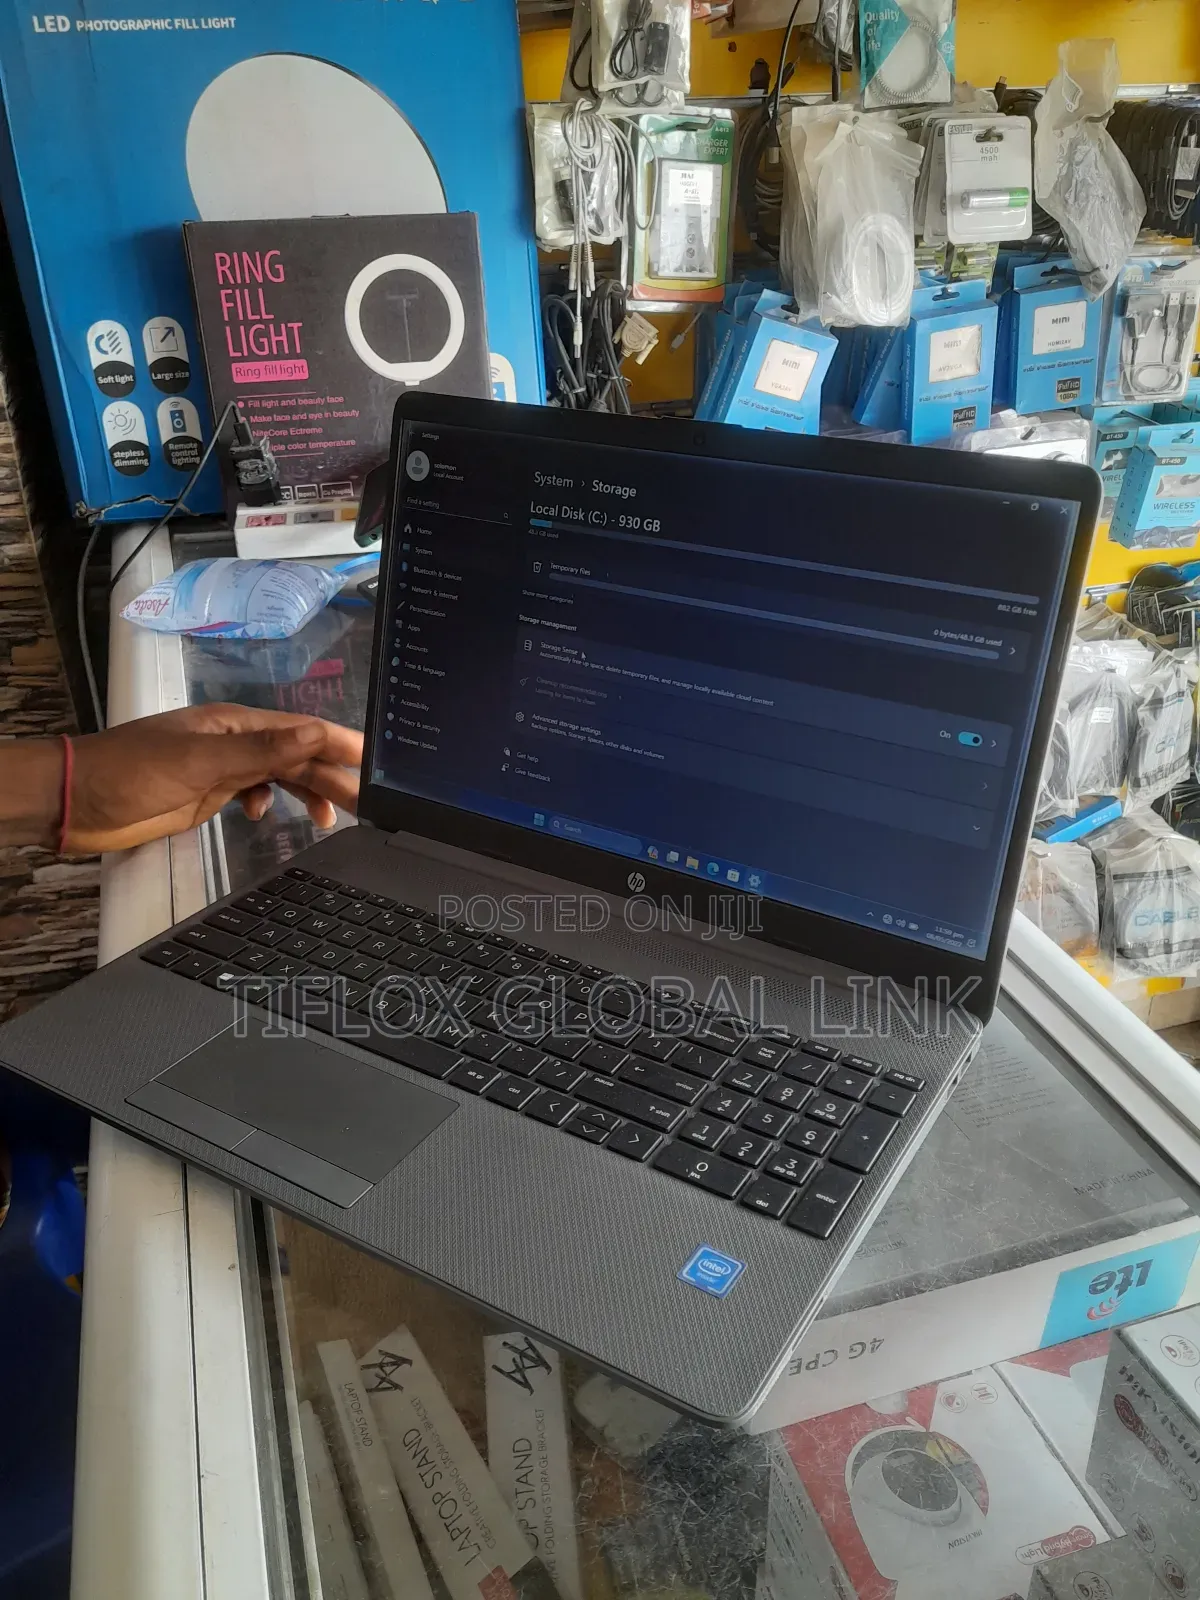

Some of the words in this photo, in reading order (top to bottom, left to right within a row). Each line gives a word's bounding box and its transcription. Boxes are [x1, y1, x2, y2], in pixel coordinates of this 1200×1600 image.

[865, 8, 900, 24] Quality
[32, 15, 70, 33] LED
[76, 18, 173, 32] PHOTOGRAPHIC
[174, 18, 200, 30] FILL
[200, 17, 236, 29] LIGHT
[867, 26, 877, 36] of
[866, 40, 881, 51] life
[703, 147, 729, 156] EXPERT
[980, 146, 999, 154] 4500
[214, 250, 286, 285] RING
[220, 287, 275, 321] FILL
[1052, 316, 1070, 325] MINI
[225, 322, 303, 357] LIGHT
[781, 358, 801, 370] MINI
[152, 371, 174, 381] Large
[174, 370, 190, 379] size
[235, 365, 261, 379] Ring
[264, 364, 278, 377] fill
[279, 364, 306, 377] light
[98, 375, 114, 385] Soft
[114, 374, 134, 385] light
[262, 399, 279, 409] light
[281, 399, 297, 407] and
[297, 396, 325, 407] beauty
[250, 415, 272, 424] Make
[292, 412, 308, 420] and
[308, 411, 323, 421] eye
[333, 409, 359, 418] beauty
[168, 442, 198, 450] Remote
[287, 442, 307, 450] color
[308, 439, 356, 449] temperature
[113, 450, 145, 459] stepless
[171, 449, 198, 457] control
[114, 457, 149, 467] dimming
[172, 456, 200, 466] lighting
[534, 471, 574, 489] System
[592, 479, 637, 499] Storage
[1153, 501, 1196, 511] WIRELESS
[530, 501, 559, 517] Local
[561, 505, 585, 521] Disk
[588, 510, 608, 526] (C:)
[618, 514, 640, 530] 930
[643, 518, 661, 533] GB
[416, 526, 432, 535] Home
[415, 546, 433, 556] System
[413, 566, 437, 577] Bluetooth
[550, 562, 579, 575] Temporary
[579, 567, 591, 576] files
[1022, 607, 1038, 616] free
[518, 614, 540, 625] Storage
[540, 641, 561, 653] Storage
[986, 638, 1003, 647] used
[532, 713, 558, 725] Advanced
[939, 730, 951, 739] On
[516, 751, 527, 759] Get
[527, 753, 539, 763] help
[515, 767, 527, 776] Give
[527, 770, 551, 782] feedback
[628, 872, 645, 892] hp
[758, 1050, 772, 1059] lock
[760, 1047, 776, 1055] num
[594, 1077, 614, 1088] pause
[675, 1082, 694, 1091] enter
[732, 1078, 752, 1088] home
[508, 1086, 521, 1094] ctrl
[655, 1108, 671, 1118] shift
[691, 1132, 707, 1141] end
[1073, 1180, 1105, 1196] MADE
[756, 1199, 769, 1208] del
[815, 1193, 837, 1204] enter
[703, 1260, 727, 1273] intel
[848, 1337, 884, 1361] 4G
[788, 1349, 840, 1377] CPE
[355, 1416, 373, 1448] STAND
[534, 1408, 548, 1452] BRACKET
[403, 1428, 442, 1489] STAND
[512, 1437, 536, 1511] STAND
[537, 1453, 552, 1506] STORAGE
[432, 1491, 481, 1567] LAPTOP
[543, 1506, 557, 1556] FOLDING
[1043, 1536, 1072, 1552] Hybrid
